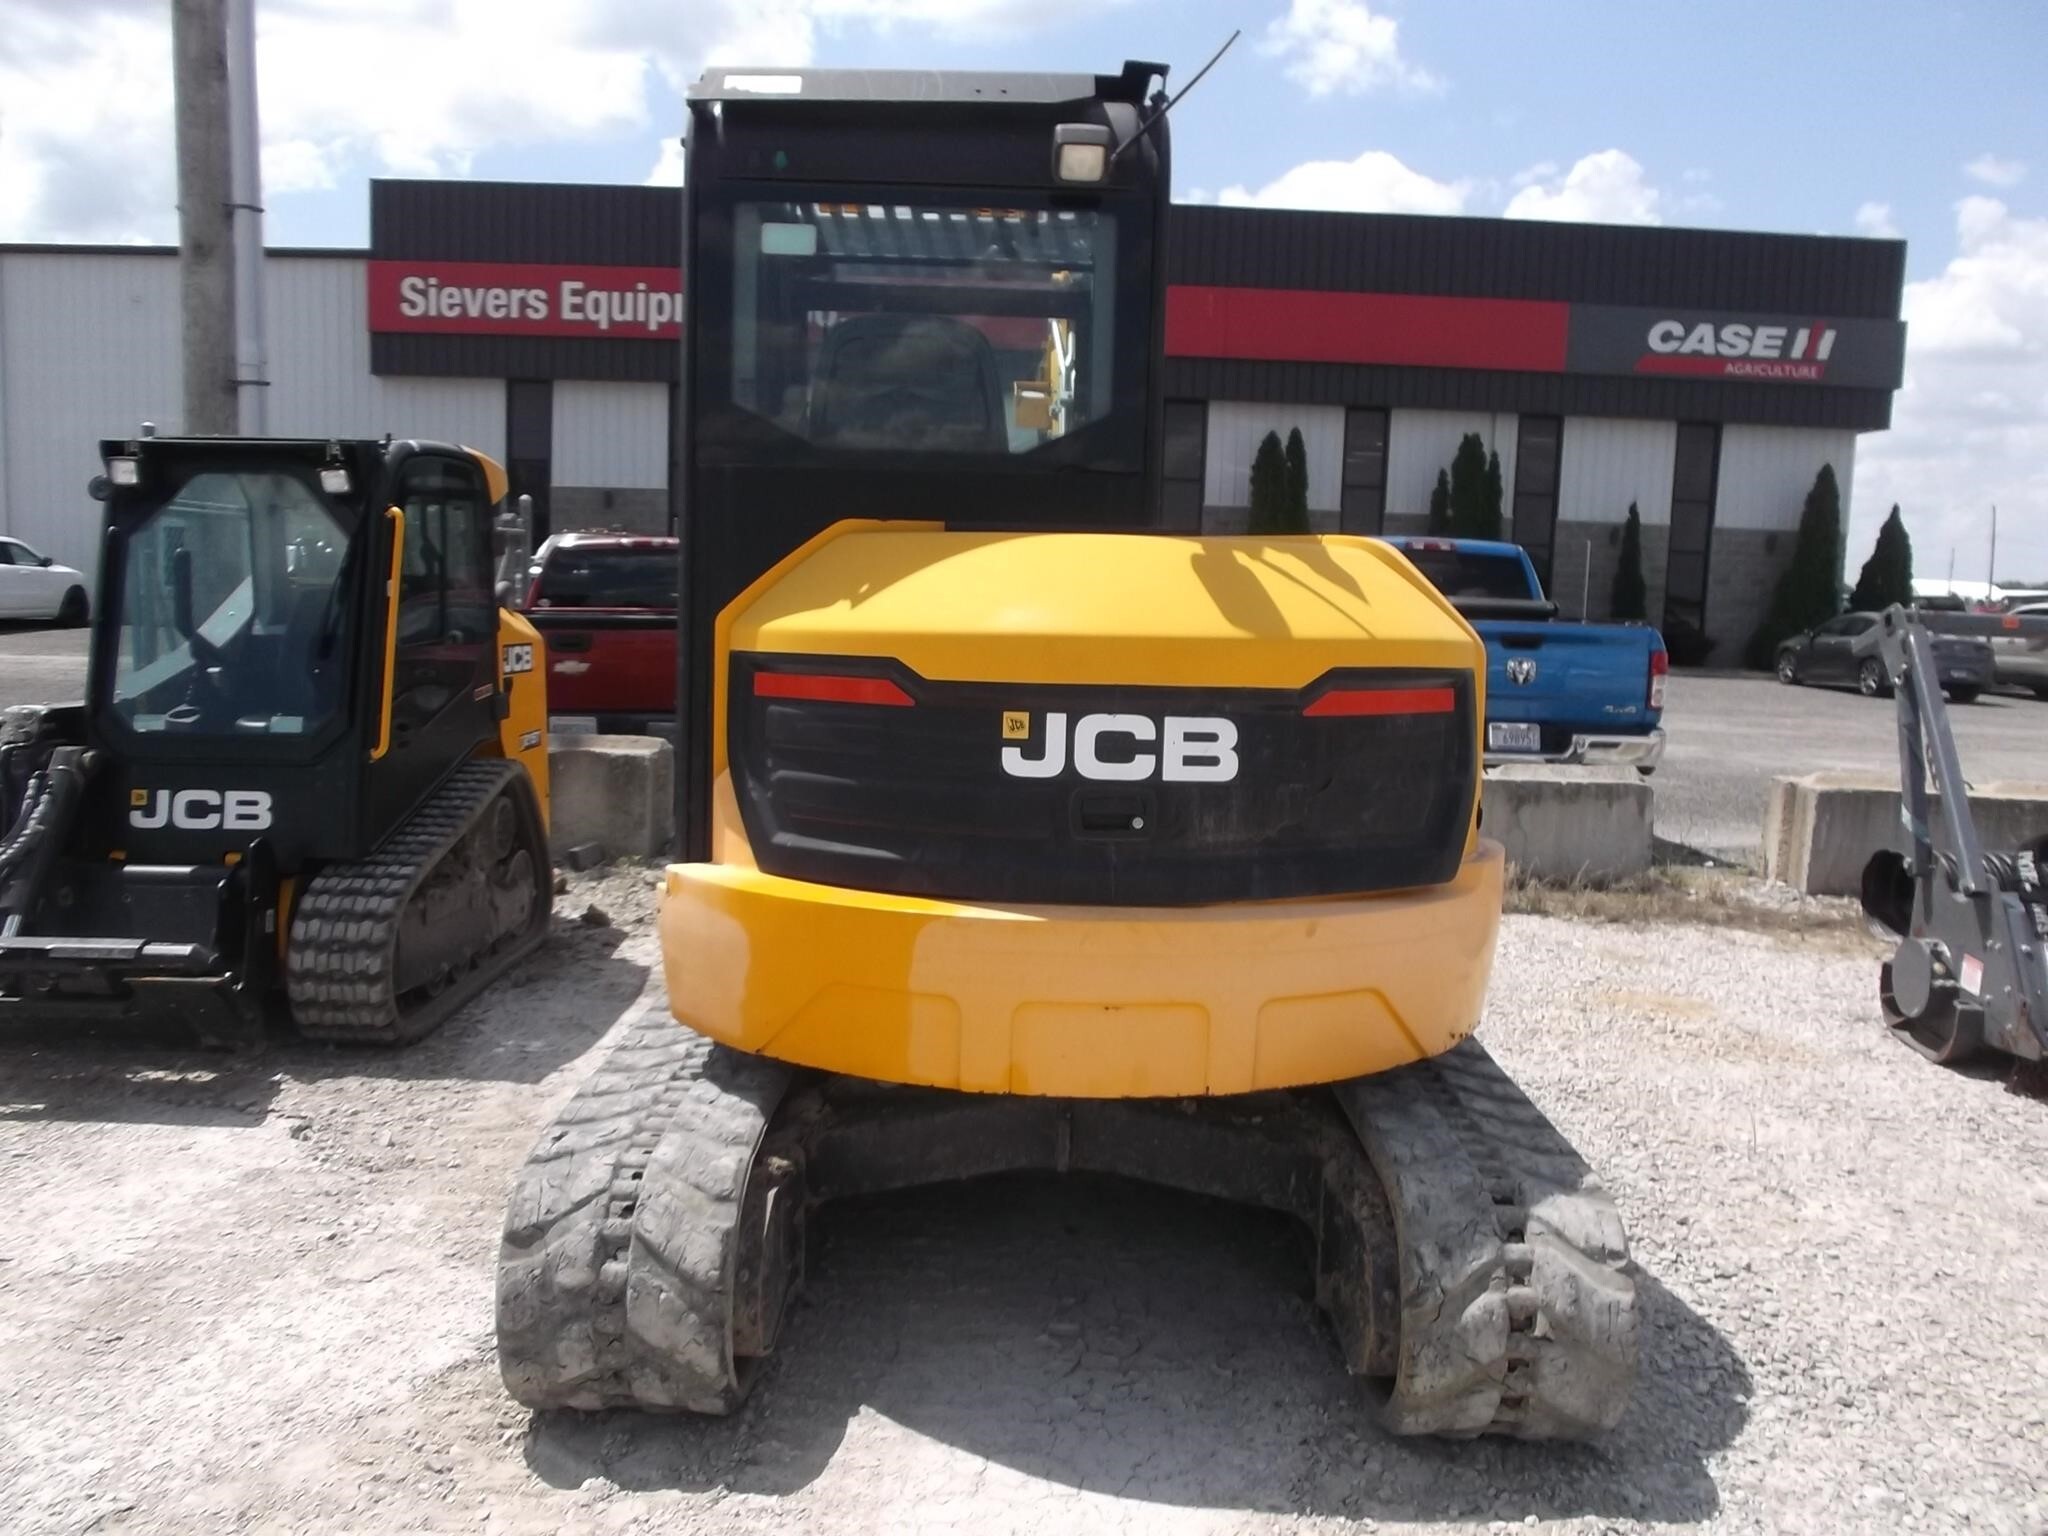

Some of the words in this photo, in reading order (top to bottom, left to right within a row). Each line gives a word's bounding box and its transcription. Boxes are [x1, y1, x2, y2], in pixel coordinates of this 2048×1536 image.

[400, 275, 549, 320] Sievers
[1647, 319, 1788, 358] CASE
[1724, 361, 1819, 380] AGRICULTURE
[503, 645, 533, 674] JCB
[1001, 712, 1240, 783] JCB
[129, 789, 273, 831] JCB
